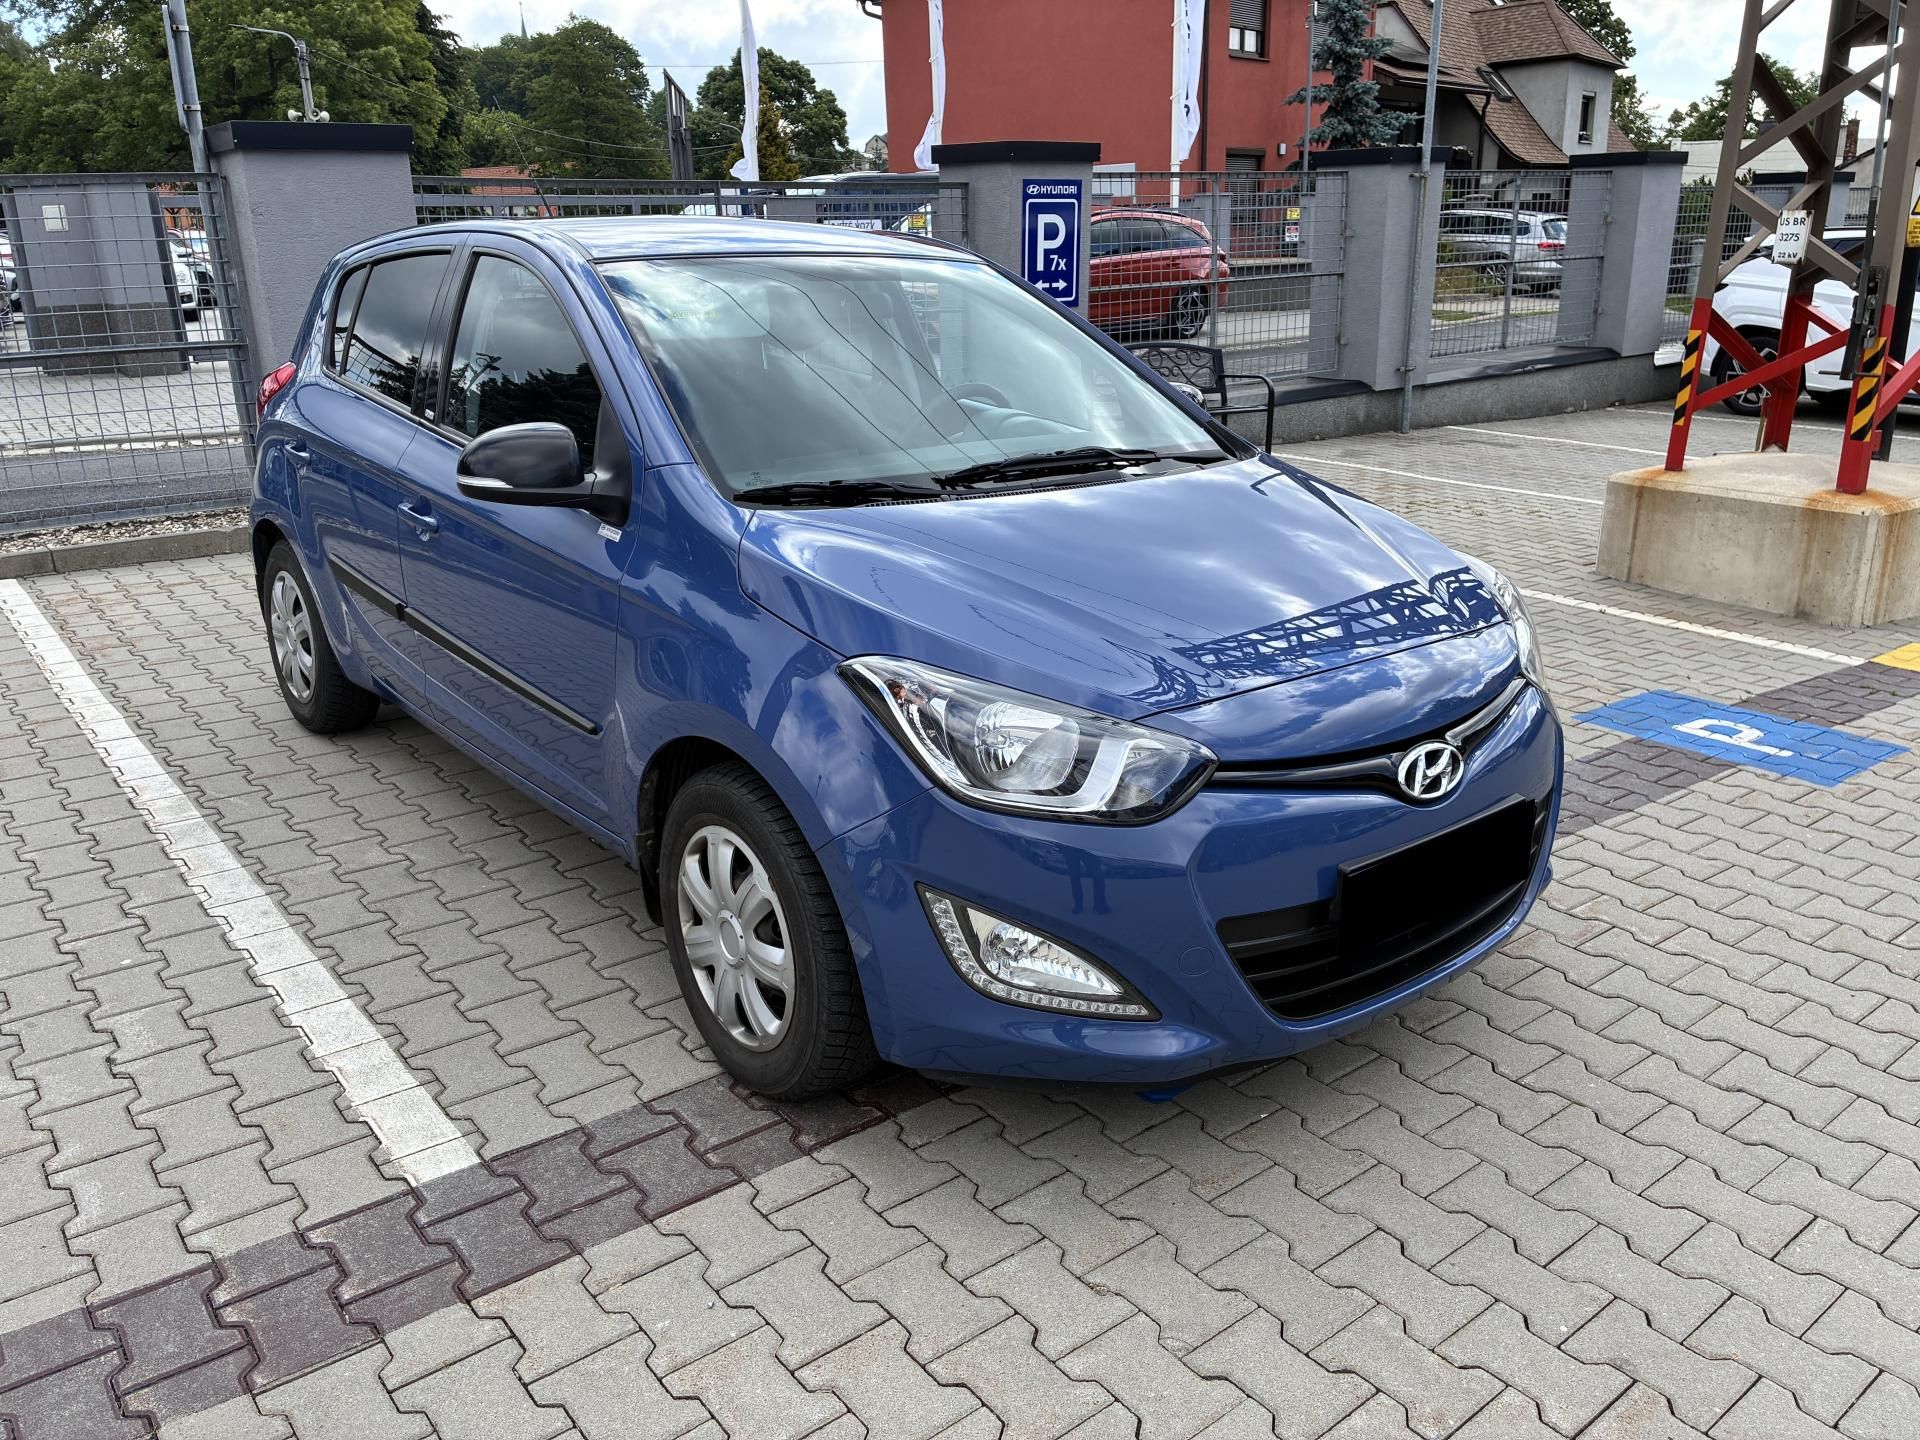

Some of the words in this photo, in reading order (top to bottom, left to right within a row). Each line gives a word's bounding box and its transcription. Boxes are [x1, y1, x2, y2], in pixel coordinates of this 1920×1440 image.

[1041, 185, 1078, 195] HYUNDAI
[1780, 217, 1790, 226] US
[1793, 217, 1806, 226] BR
[1779, 232, 1800, 242] 3275
[1037, 213, 1066, 272] P
[1050, 255, 1066, 271] 7x
